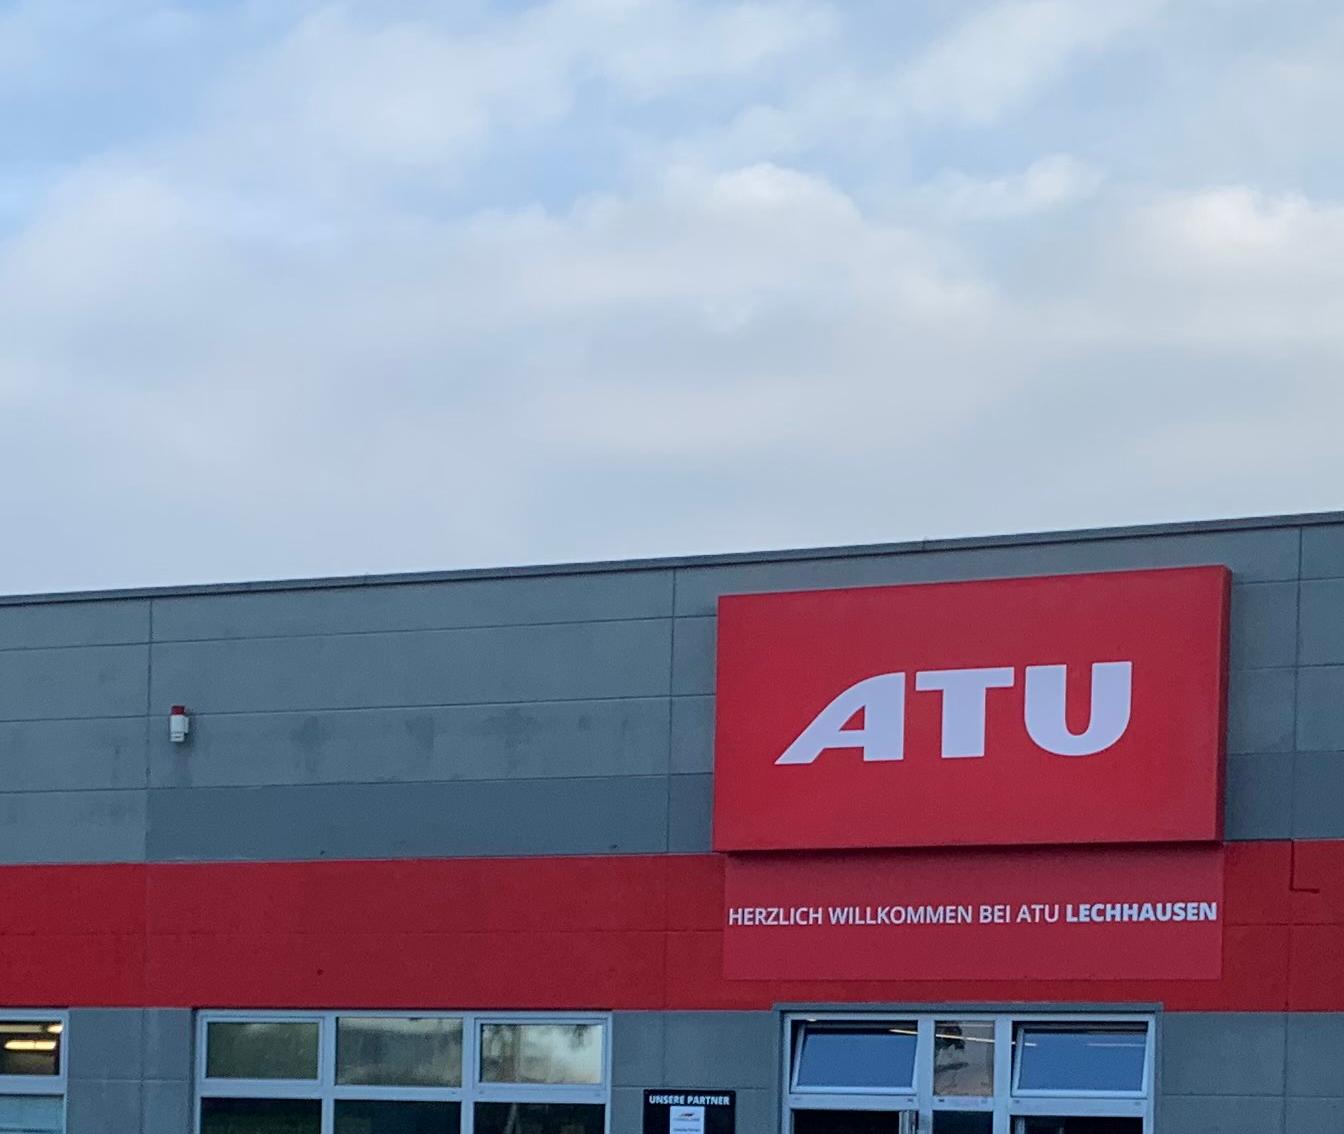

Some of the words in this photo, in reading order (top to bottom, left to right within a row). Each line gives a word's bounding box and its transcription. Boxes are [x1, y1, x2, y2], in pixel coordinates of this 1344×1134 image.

[774, 661, 1132, 765] ATU
[729, 906, 823, 926] HERZLICH
[828, 905, 973, 925] WILLKOMMEN
[979, 904, 1011, 924] BEI
[1016, 904, 1060, 923] ATU
[1065, 902, 1217, 922] LECHHAUSEN
[649, 1094, 685, 1105] UNSERE
[687, 1095, 730, 1106] PARTNER
